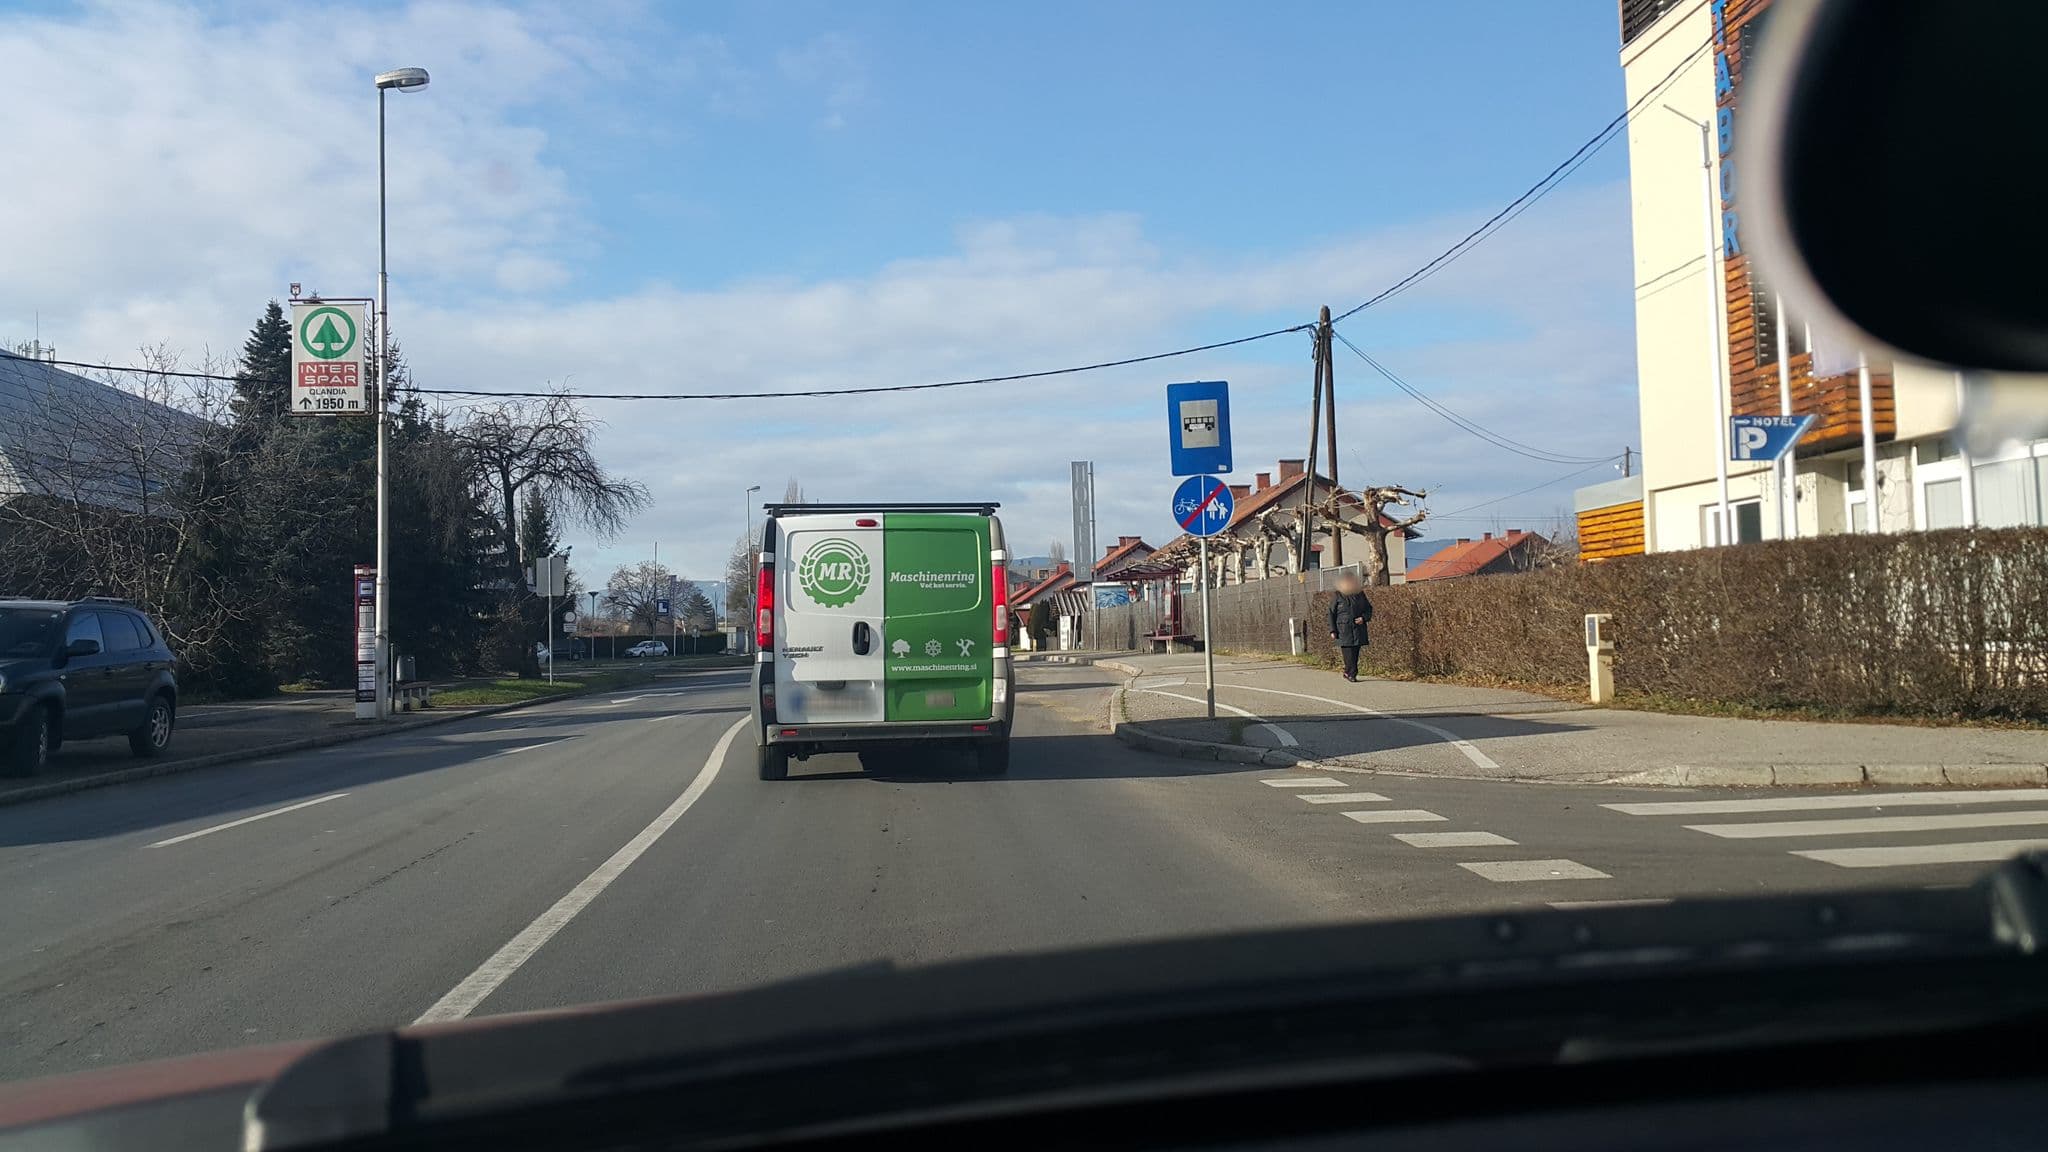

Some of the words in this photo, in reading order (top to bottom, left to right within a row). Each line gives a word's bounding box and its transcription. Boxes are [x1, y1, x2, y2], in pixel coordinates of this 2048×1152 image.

[1711, 0, 1741, 257] TABOR
[300, 364, 356, 373] INTER
[304, 375, 356, 384] SPAR
[316, 398, 344, 409] 1950
[348, 400, 358, 409] m
[1752, 416, 1797, 427] HOTEL
[1739, 426, 1767, 459] P
[818, 562, 852, 581] MR
[889, 571, 975, 584] Maschinenring
[891, 664, 977, 672] www.maschinenring.si
